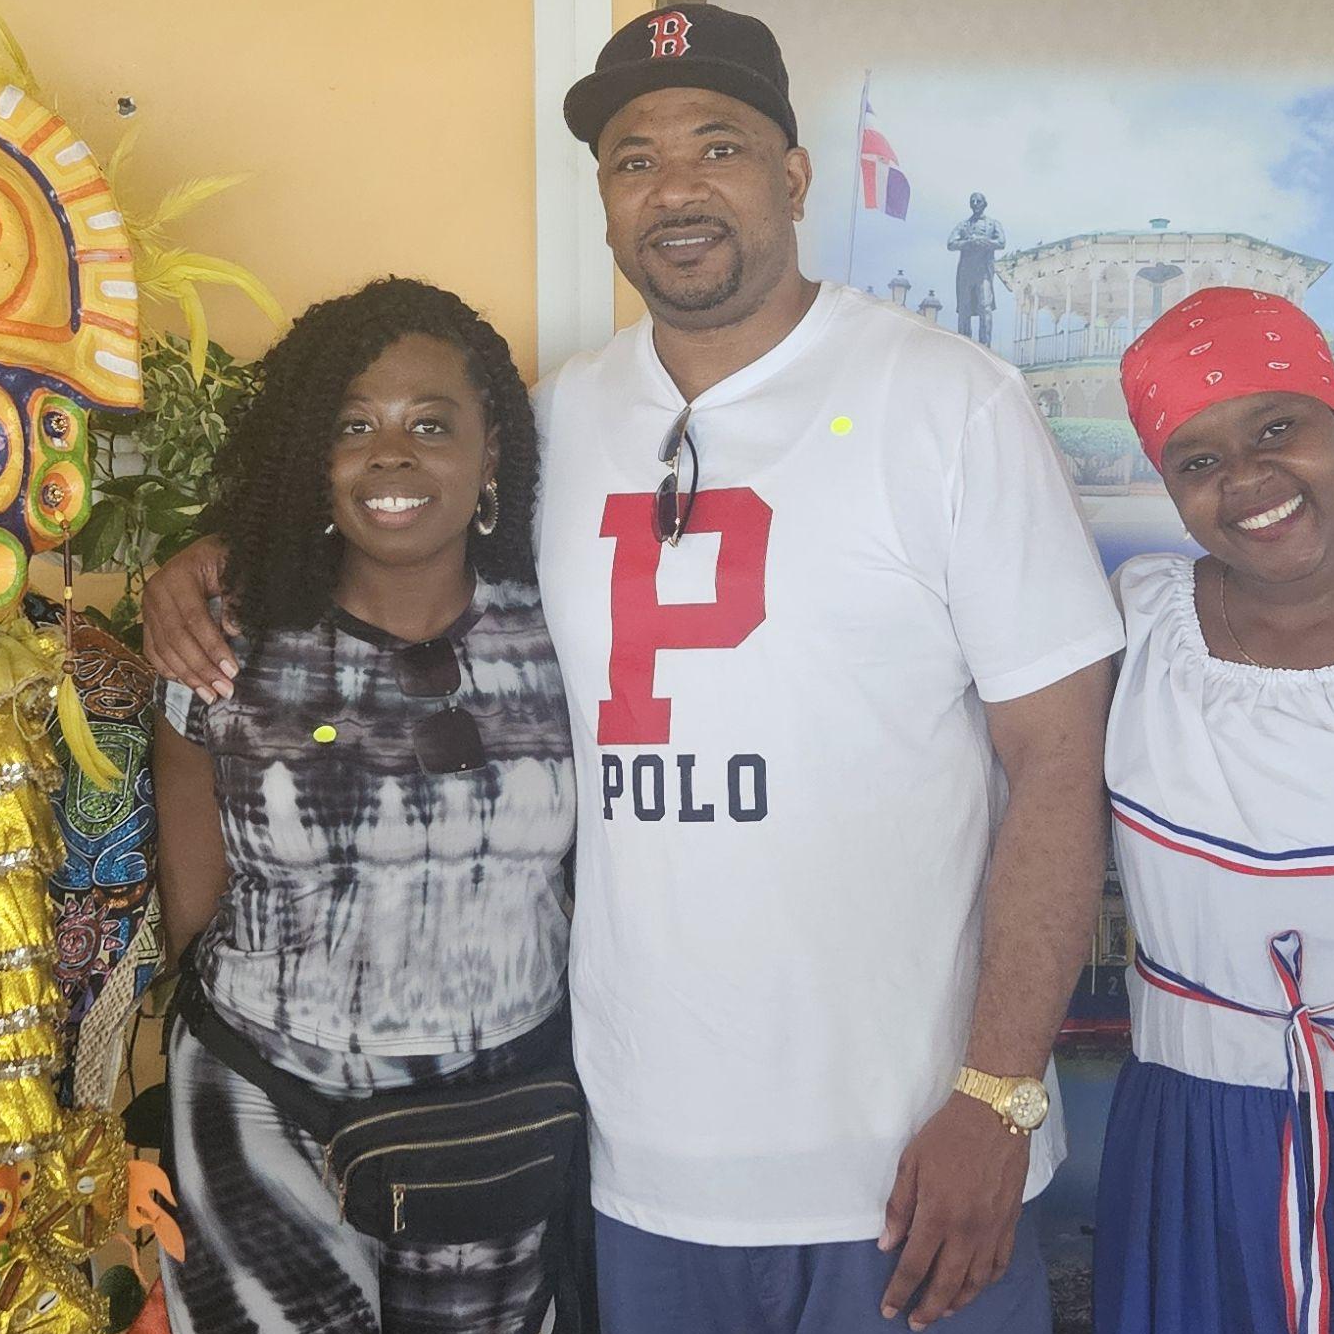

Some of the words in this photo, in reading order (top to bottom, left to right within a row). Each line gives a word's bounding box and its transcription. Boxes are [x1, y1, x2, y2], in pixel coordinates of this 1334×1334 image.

[648, 11, 693, 58] B
[597, 487, 773, 746] P
[601, 753, 769, 823] POLO
